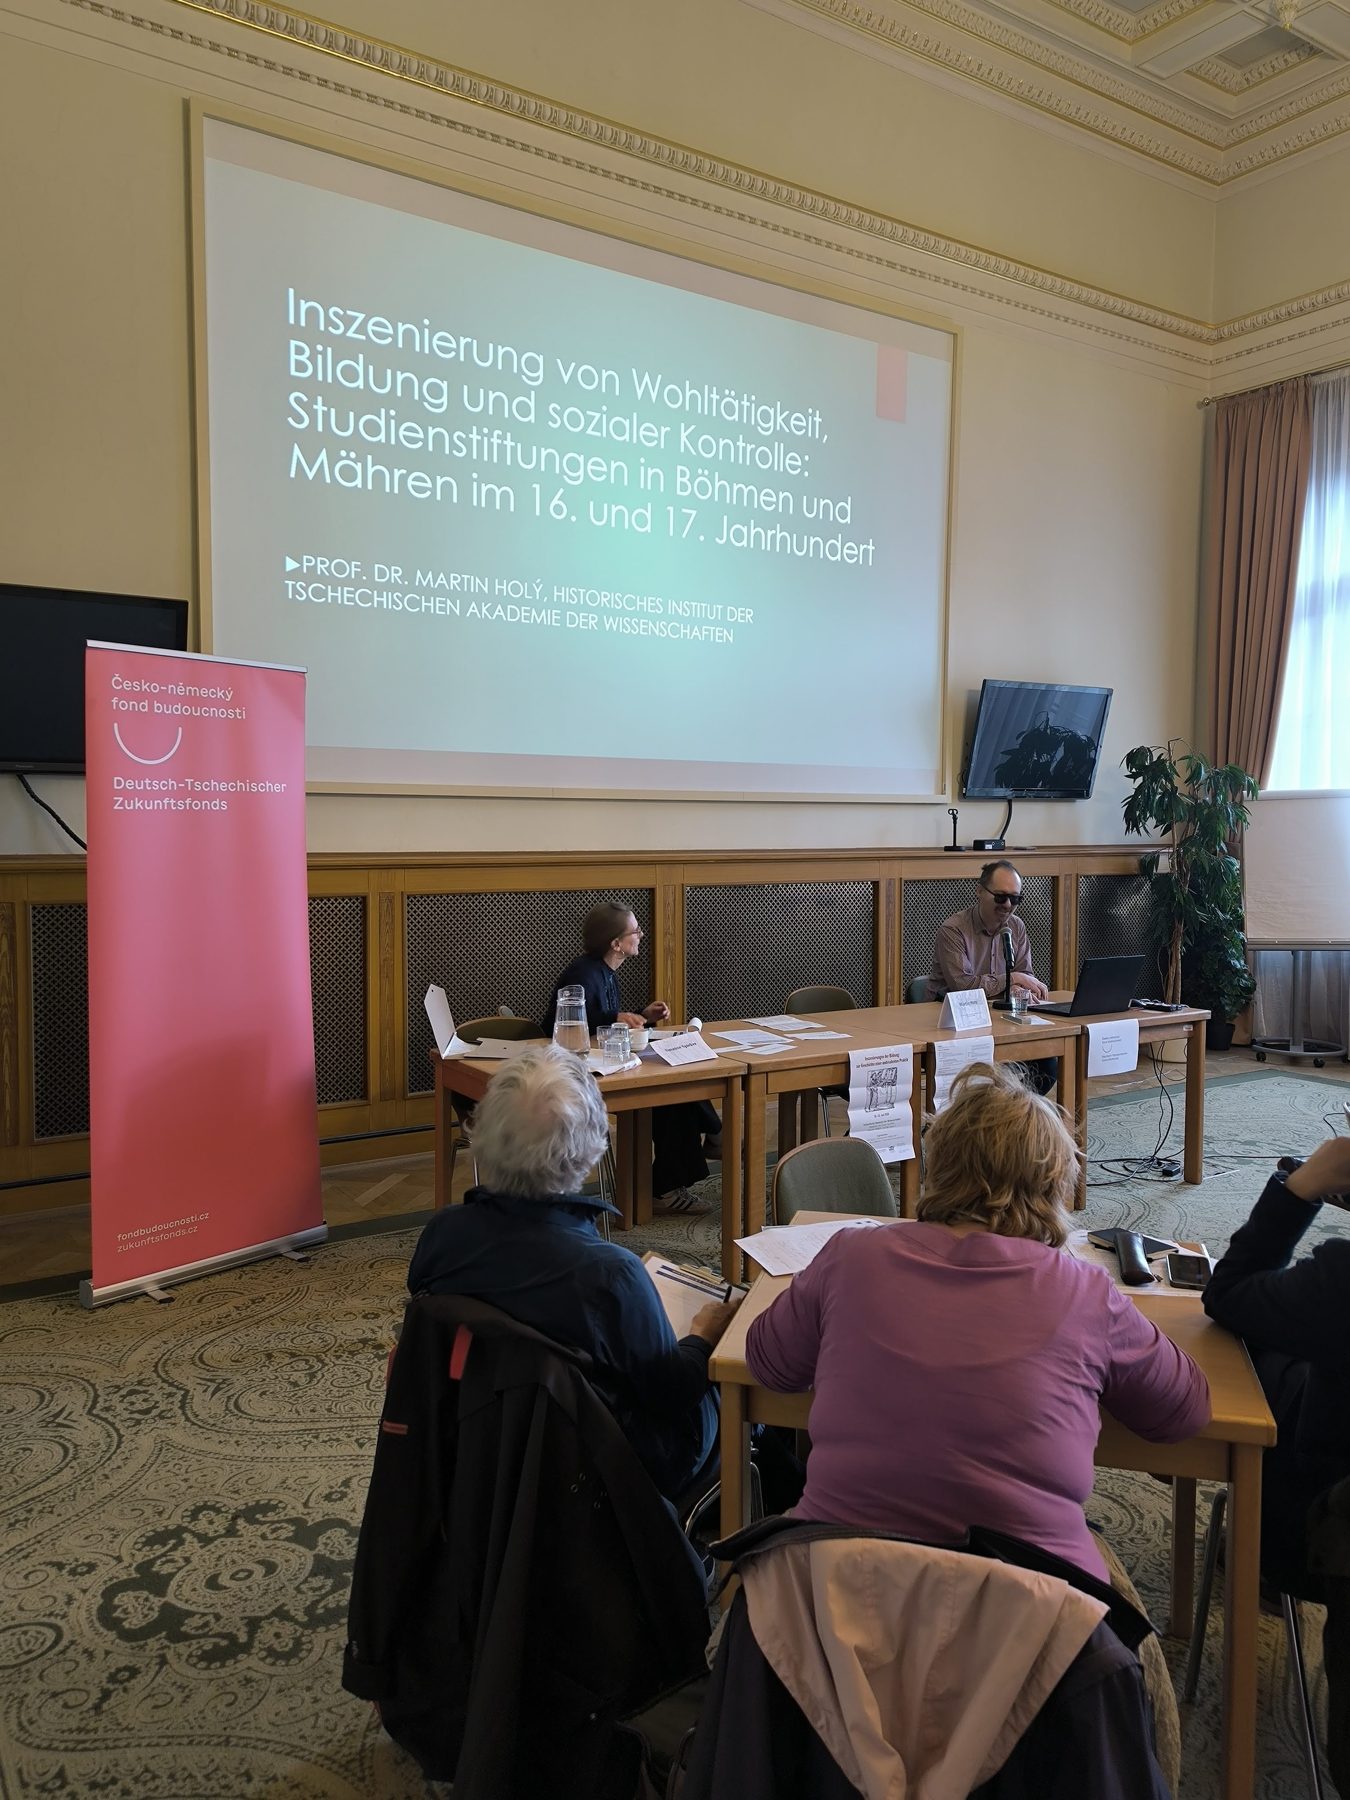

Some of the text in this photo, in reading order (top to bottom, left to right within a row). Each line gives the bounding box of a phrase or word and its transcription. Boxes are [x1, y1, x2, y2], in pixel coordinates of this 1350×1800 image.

[289, 287, 829, 444] Inszenierung von Wohltätigkeit,
[289, 339, 809, 479] Bildung und sozialer Kontrolle:
[287, 391, 852, 525] Studienstiftungen in Böhmen und
[289, 442, 876, 567] Mähren im 16. und 17. Jahrhundert
[285, 579, 734, 643] TSCHECHISCHEN AKADEMIE DER WISSENSCHAFTEN
[302, 554, 755, 624] PROF. DR. MARTIN HOLÝ, HISTORISCHES INSTITUT DER
[111, 673, 234, 702] Česko-německý
[111, 697, 247, 720] fond budoucnosti
[112, 797, 228, 811] Zukunftsfonds
[113, 776, 287, 793] Deutsch-Tschechischer
[117, 1212, 210, 1242] fondbudoucnosti.cz
[117, 1226, 199, 1253] zukunftsfonds.cz
